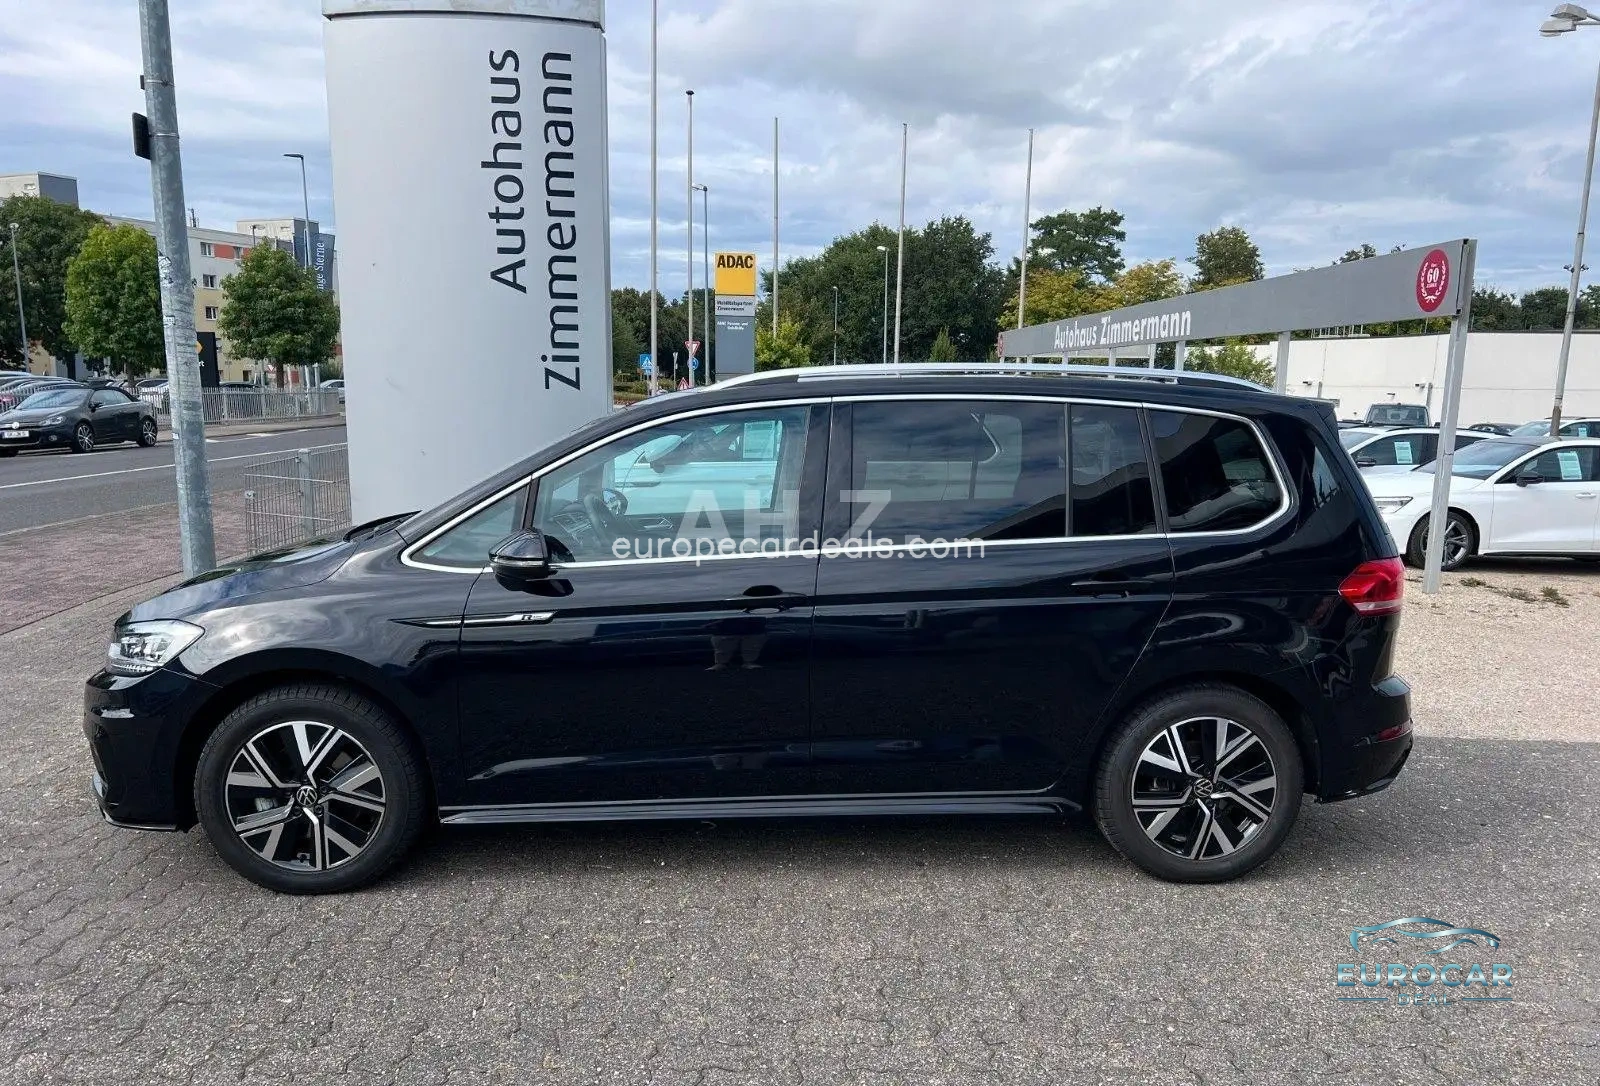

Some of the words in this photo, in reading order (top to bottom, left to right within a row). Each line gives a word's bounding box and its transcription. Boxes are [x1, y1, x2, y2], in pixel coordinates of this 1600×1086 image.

[481, 49, 527, 294] Autohaus
[540, 51, 581, 391] Zimmermann
[717, 254, 754, 268] ADAC
[1427, 267, 1439, 283] 60
[1054, 321, 1097, 349] Autohaus
[1100, 310, 1191, 345] Zimmermann
